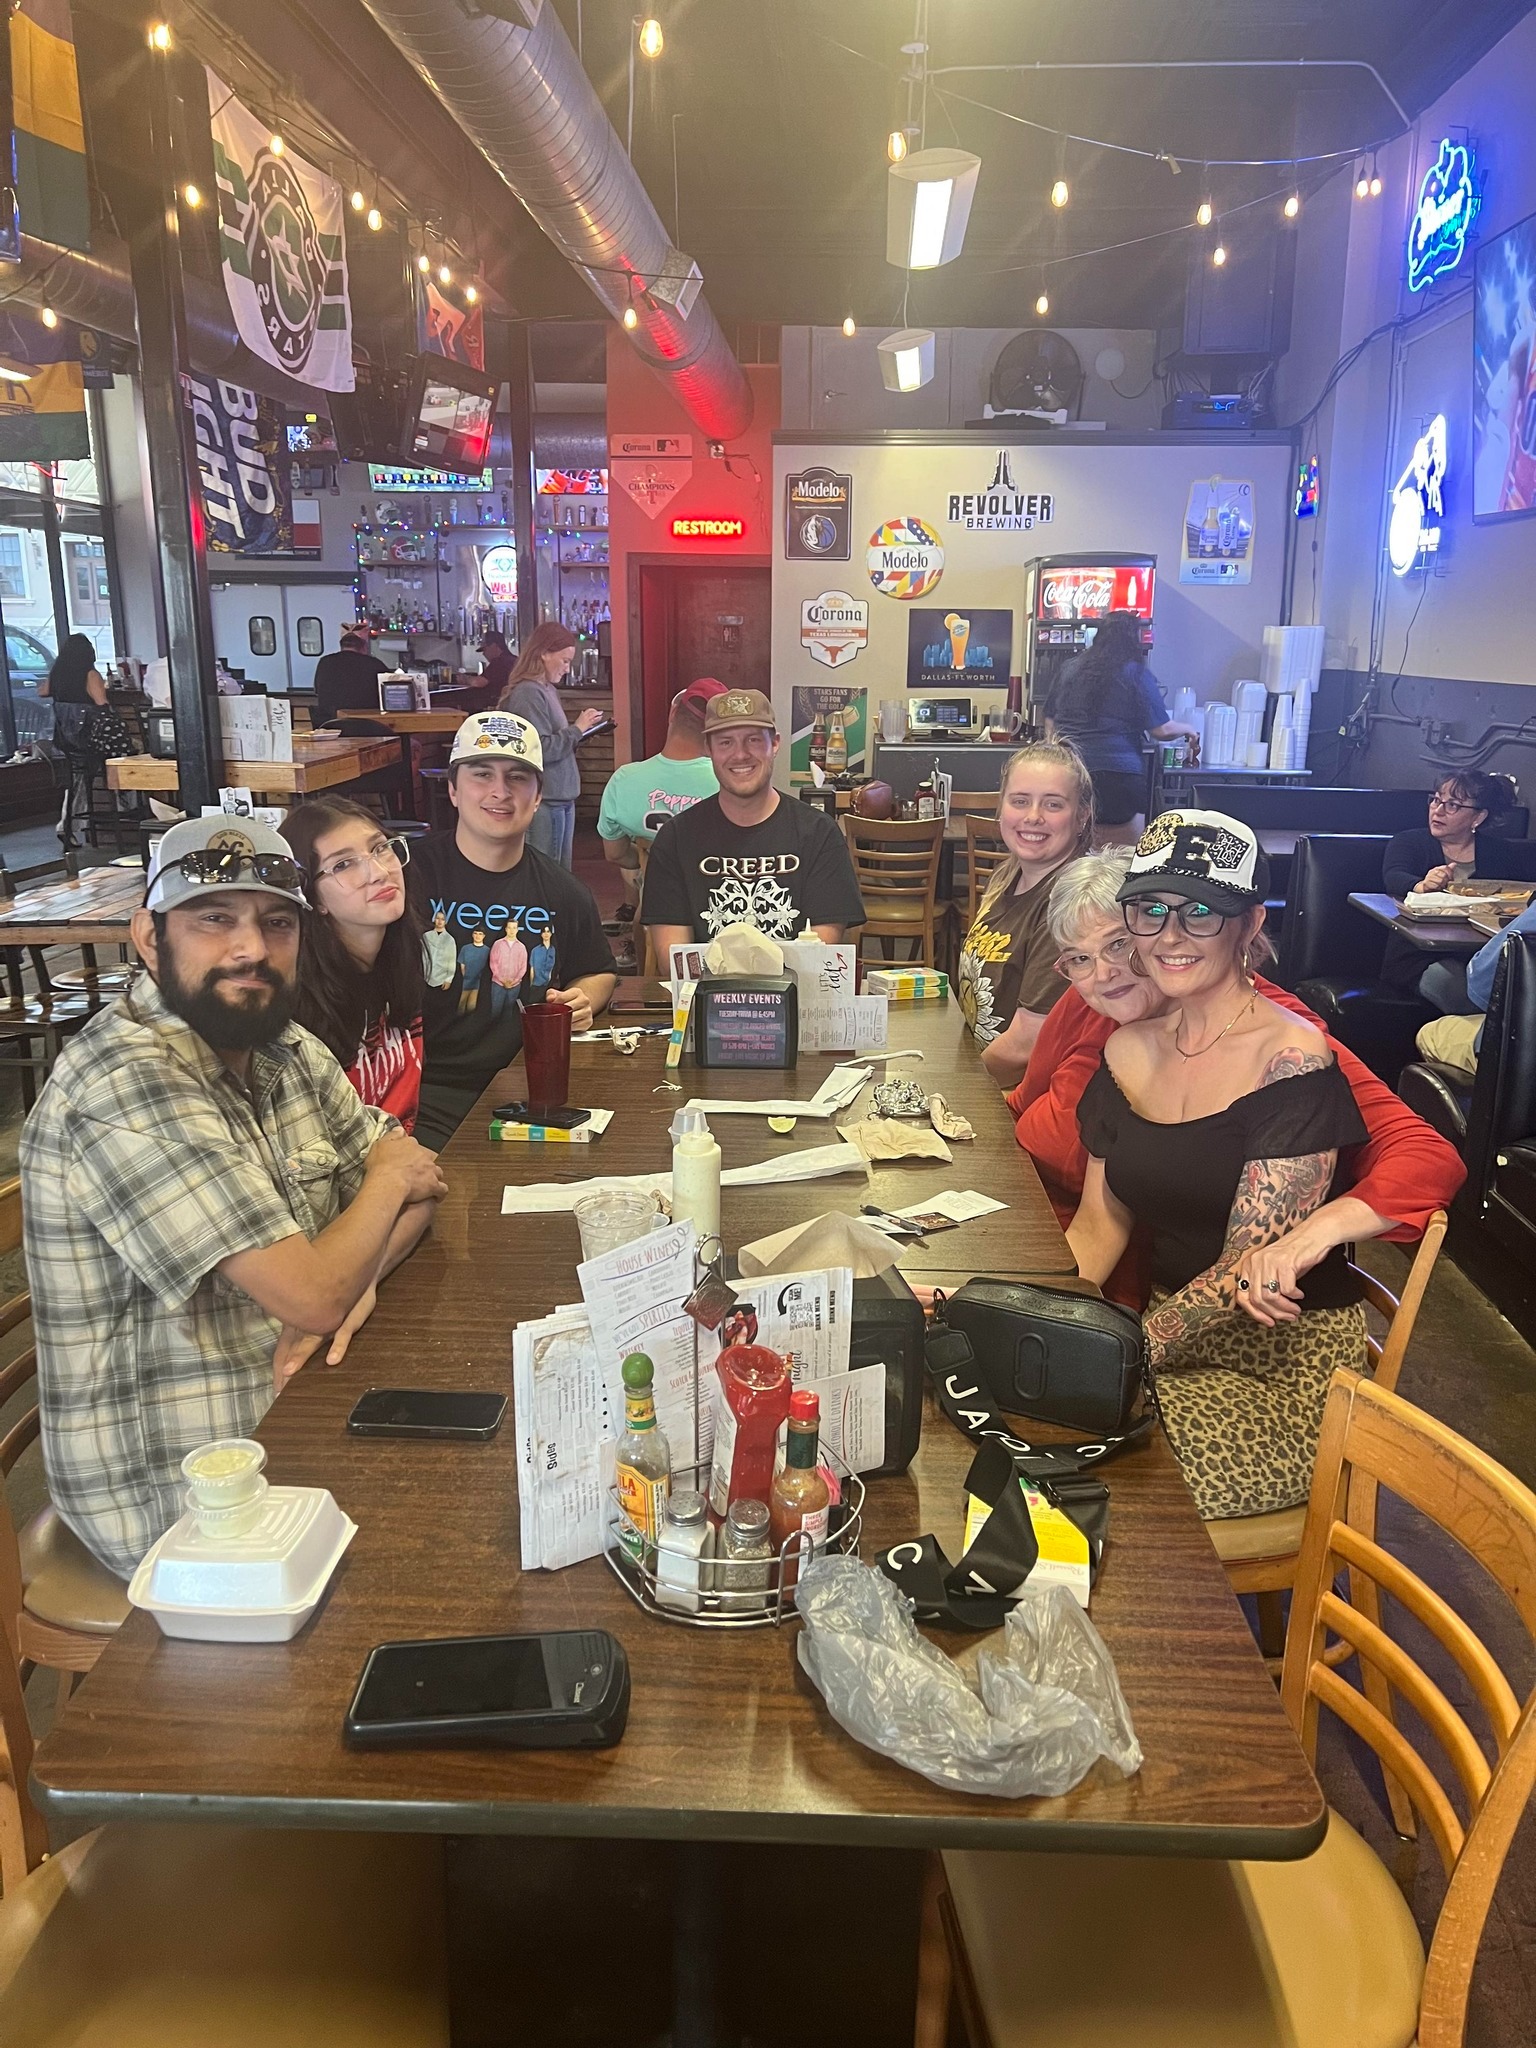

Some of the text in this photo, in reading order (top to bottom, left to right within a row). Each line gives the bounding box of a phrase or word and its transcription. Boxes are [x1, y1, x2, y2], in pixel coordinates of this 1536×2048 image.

[217, 378, 276, 515] BUD
[628, 482, 675, 491] CHAMPIONS
[798, 481, 840, 498] Modelo
[949, 494, 1052, 521] REVOLVER
[673, 520, 742, 535] RESTROOM
[966, 517, 1033, 530] BREWING
[882, 551, 929, 569] Modelo
[807, 605, 862, 625] Corona
[813, 688, 832, 696] STARS
[700, 854, 800, 881] CREED
[713, 993, 782, 1004] WEEKLY EVENTS
[615, 1253, 643, 1274] HOUSE
[639, 1303, 671, 1330] SPIRITS
[786, 1350, 809, 1381] night
[545, 1442, 558, 1470] Sides
